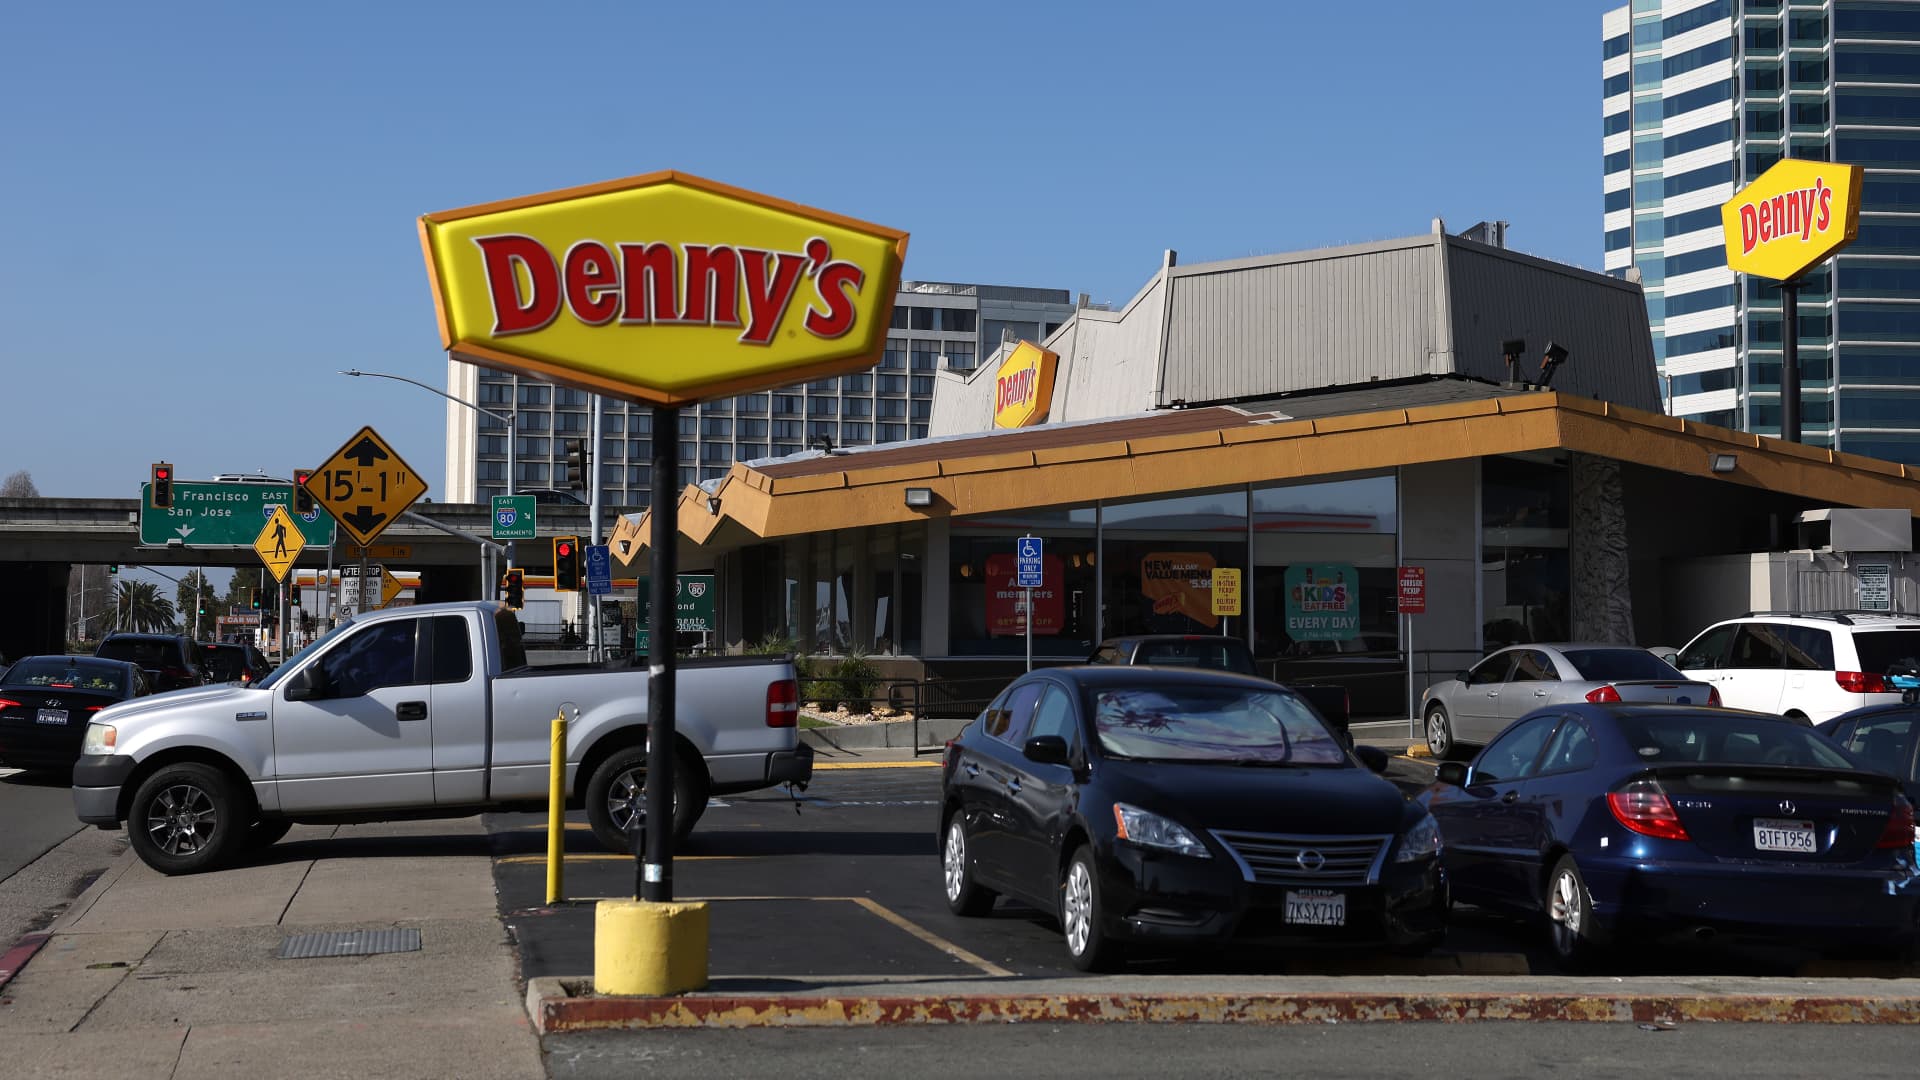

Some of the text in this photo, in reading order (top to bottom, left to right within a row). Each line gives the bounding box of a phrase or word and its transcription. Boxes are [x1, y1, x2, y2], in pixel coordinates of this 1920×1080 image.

[1739, 177, 1832, 256] Denny's
[470, 233, 864, 345] Denny's
[997, 361, 1036, 416] Denny's
[183, 491, 249, 501] Francisco
[262, 492, 288, 500] EAST
[168, 507, 232, 517] San Jose
[500, 513, 514, 523] 80
[1020, 557, 1041, 565] PARKING
[1144, 560, 1172, 570] NEW
[1023, 564, 1037, 572] ONLY
[1145, 570, 1179, 579] VALUE
[996, 590, 1053, 599] memers
[1304, 602, 1345, 610] EAT FREE
[1289, 616, 1356, 629] EVERY DAY
[1758, 830, 1812, 847] 8TFT956
[1288, 902, 1344, 920] 7KSX710
